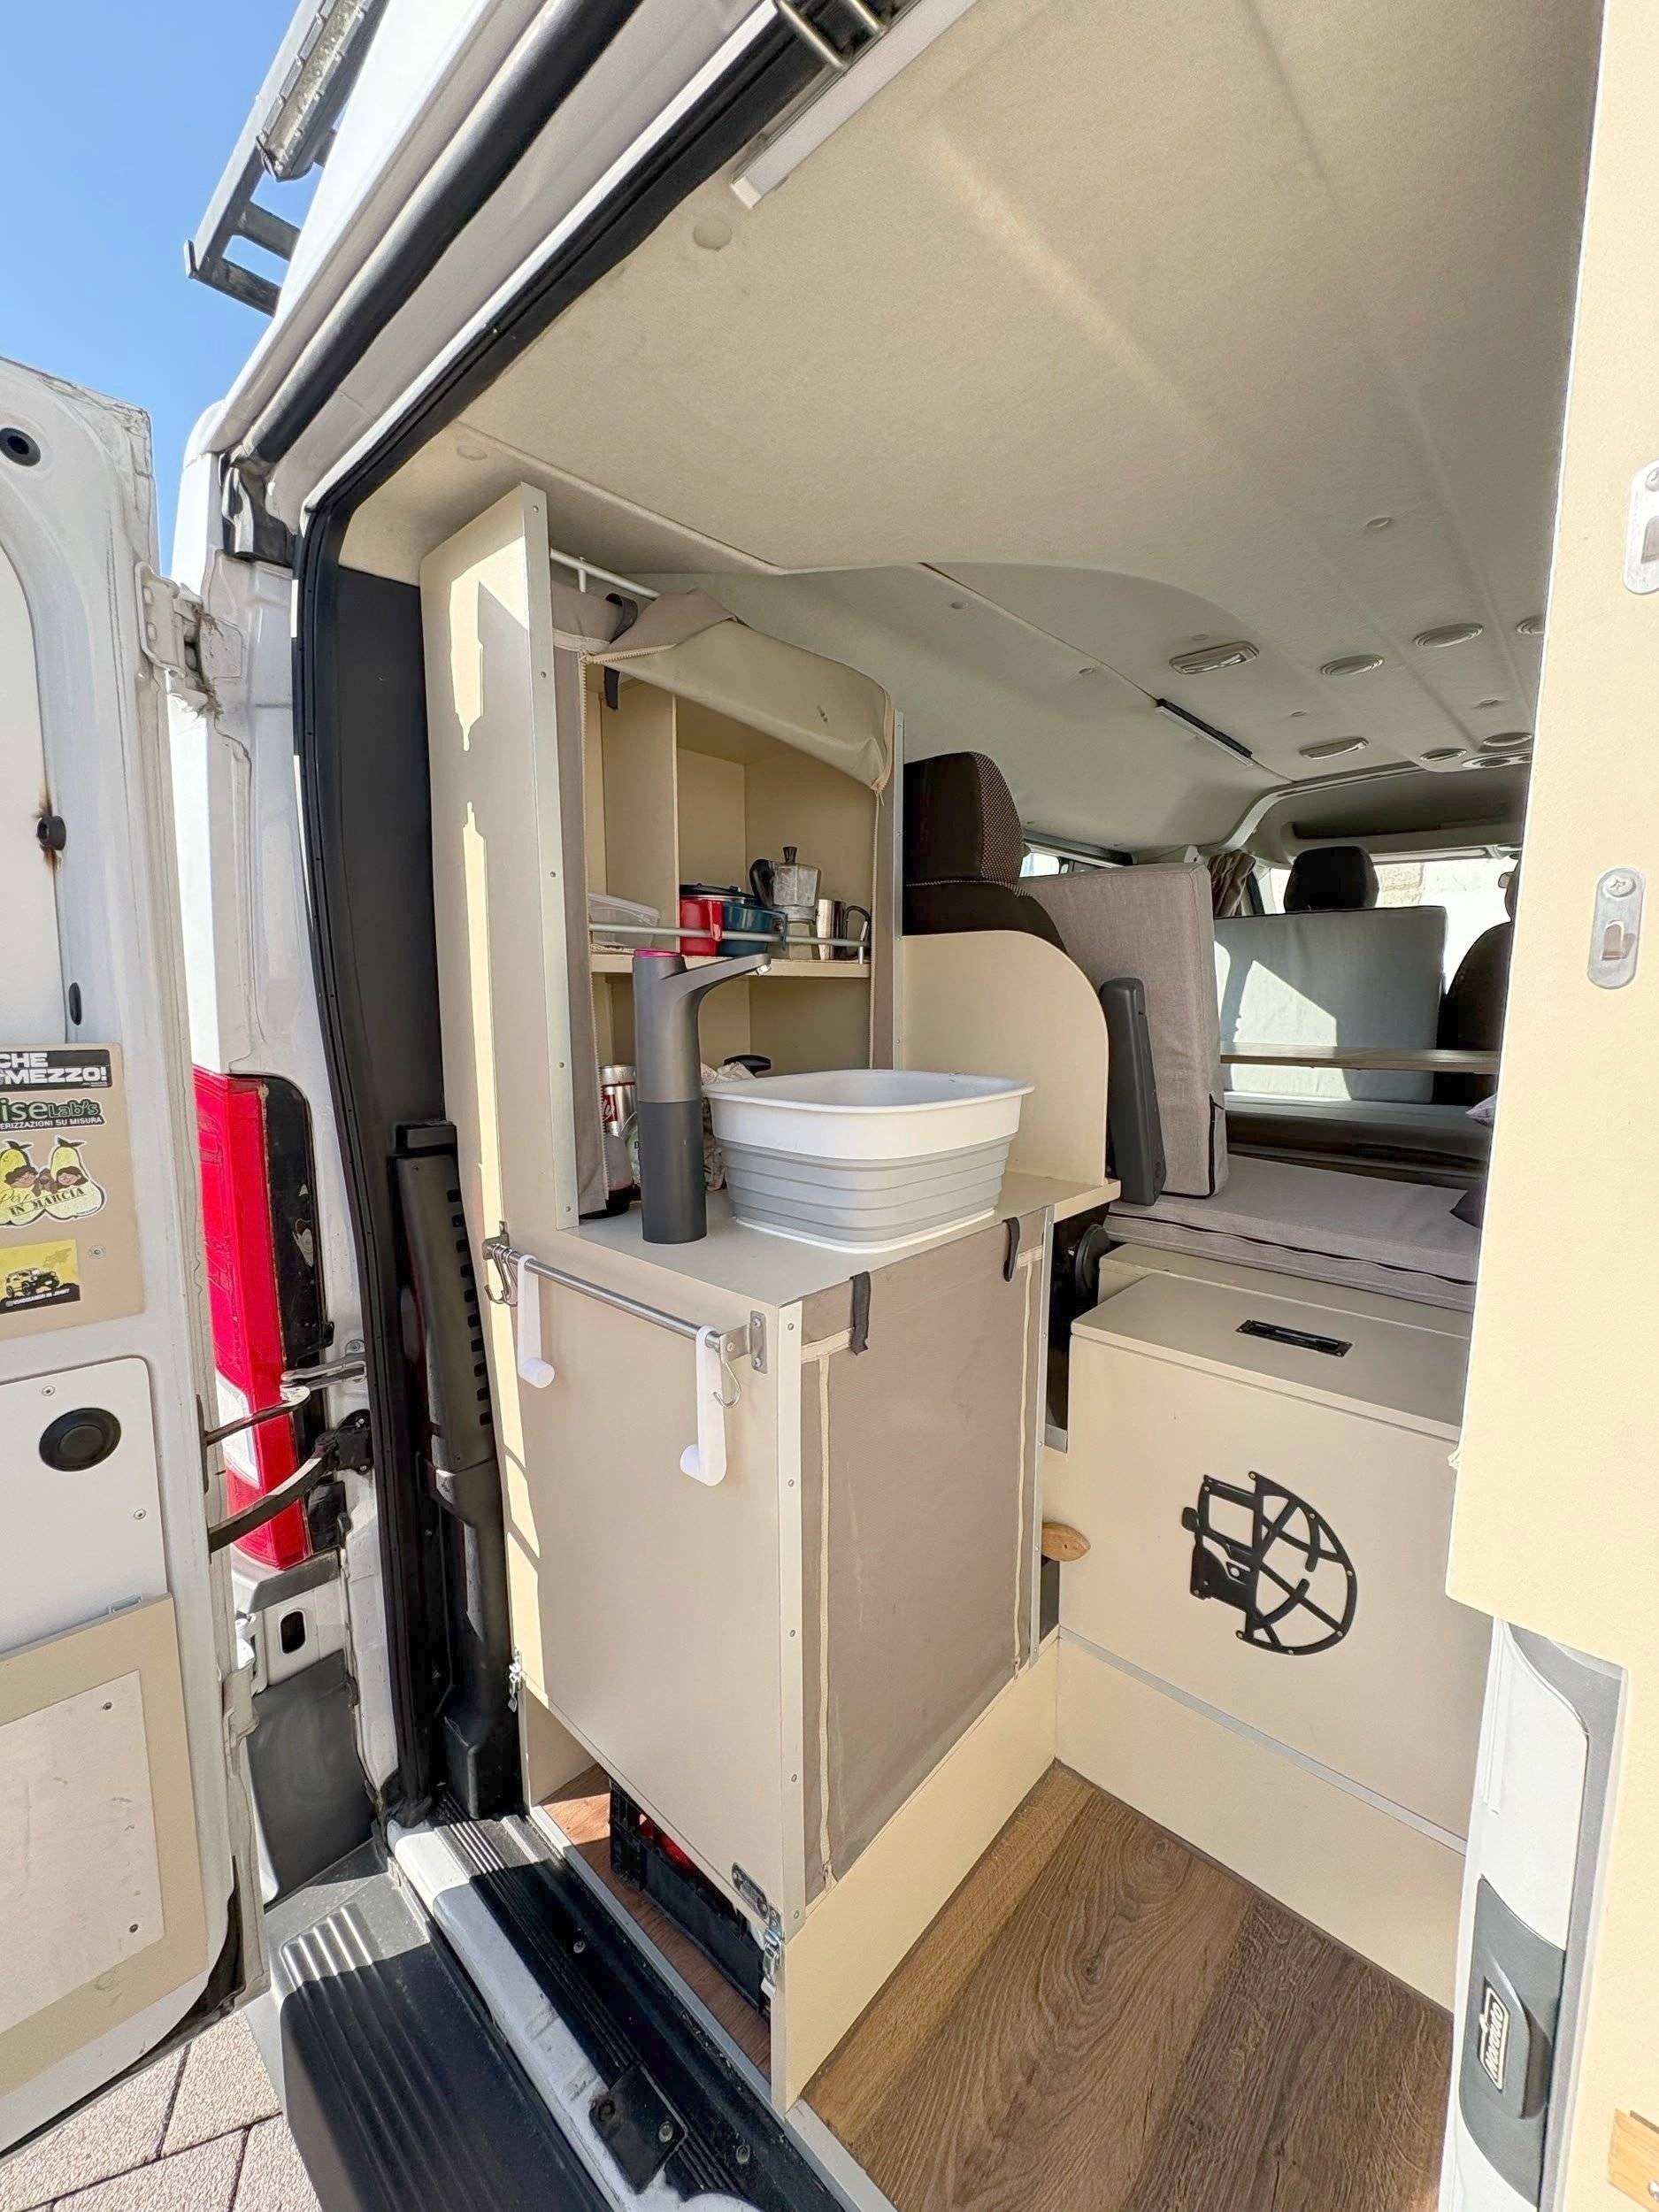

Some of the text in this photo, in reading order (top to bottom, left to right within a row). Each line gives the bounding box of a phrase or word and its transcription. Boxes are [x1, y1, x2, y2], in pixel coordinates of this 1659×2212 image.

[9, 1187, 84, 1216] IN MARCIA
[1486, 2001, 1503, 2080] Norauto
